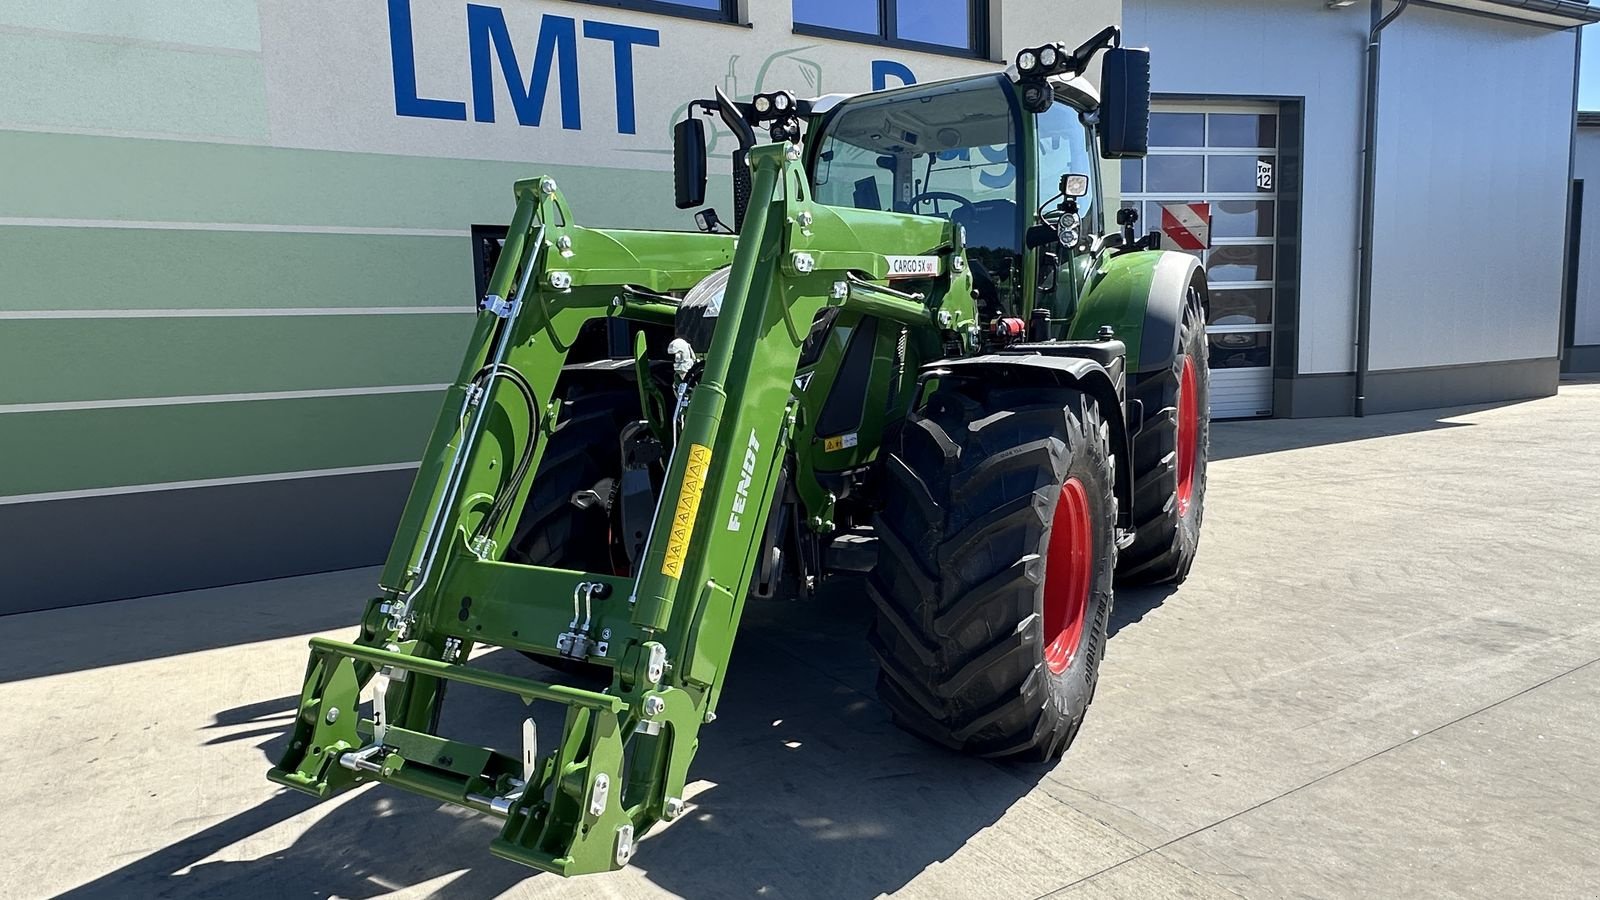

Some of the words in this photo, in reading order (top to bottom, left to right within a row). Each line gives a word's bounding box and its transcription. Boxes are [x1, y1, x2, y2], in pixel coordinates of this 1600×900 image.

[388, 0, 660, 135] LMT
[1258, 174, 1271, 186] 12
[894, 259, 917, 272] CARGO
[918, 259, 926, 272] 5X
[727, 427, 760, 532] FENDT
[1085, 591, 1109, 685] TRELLEBORG
